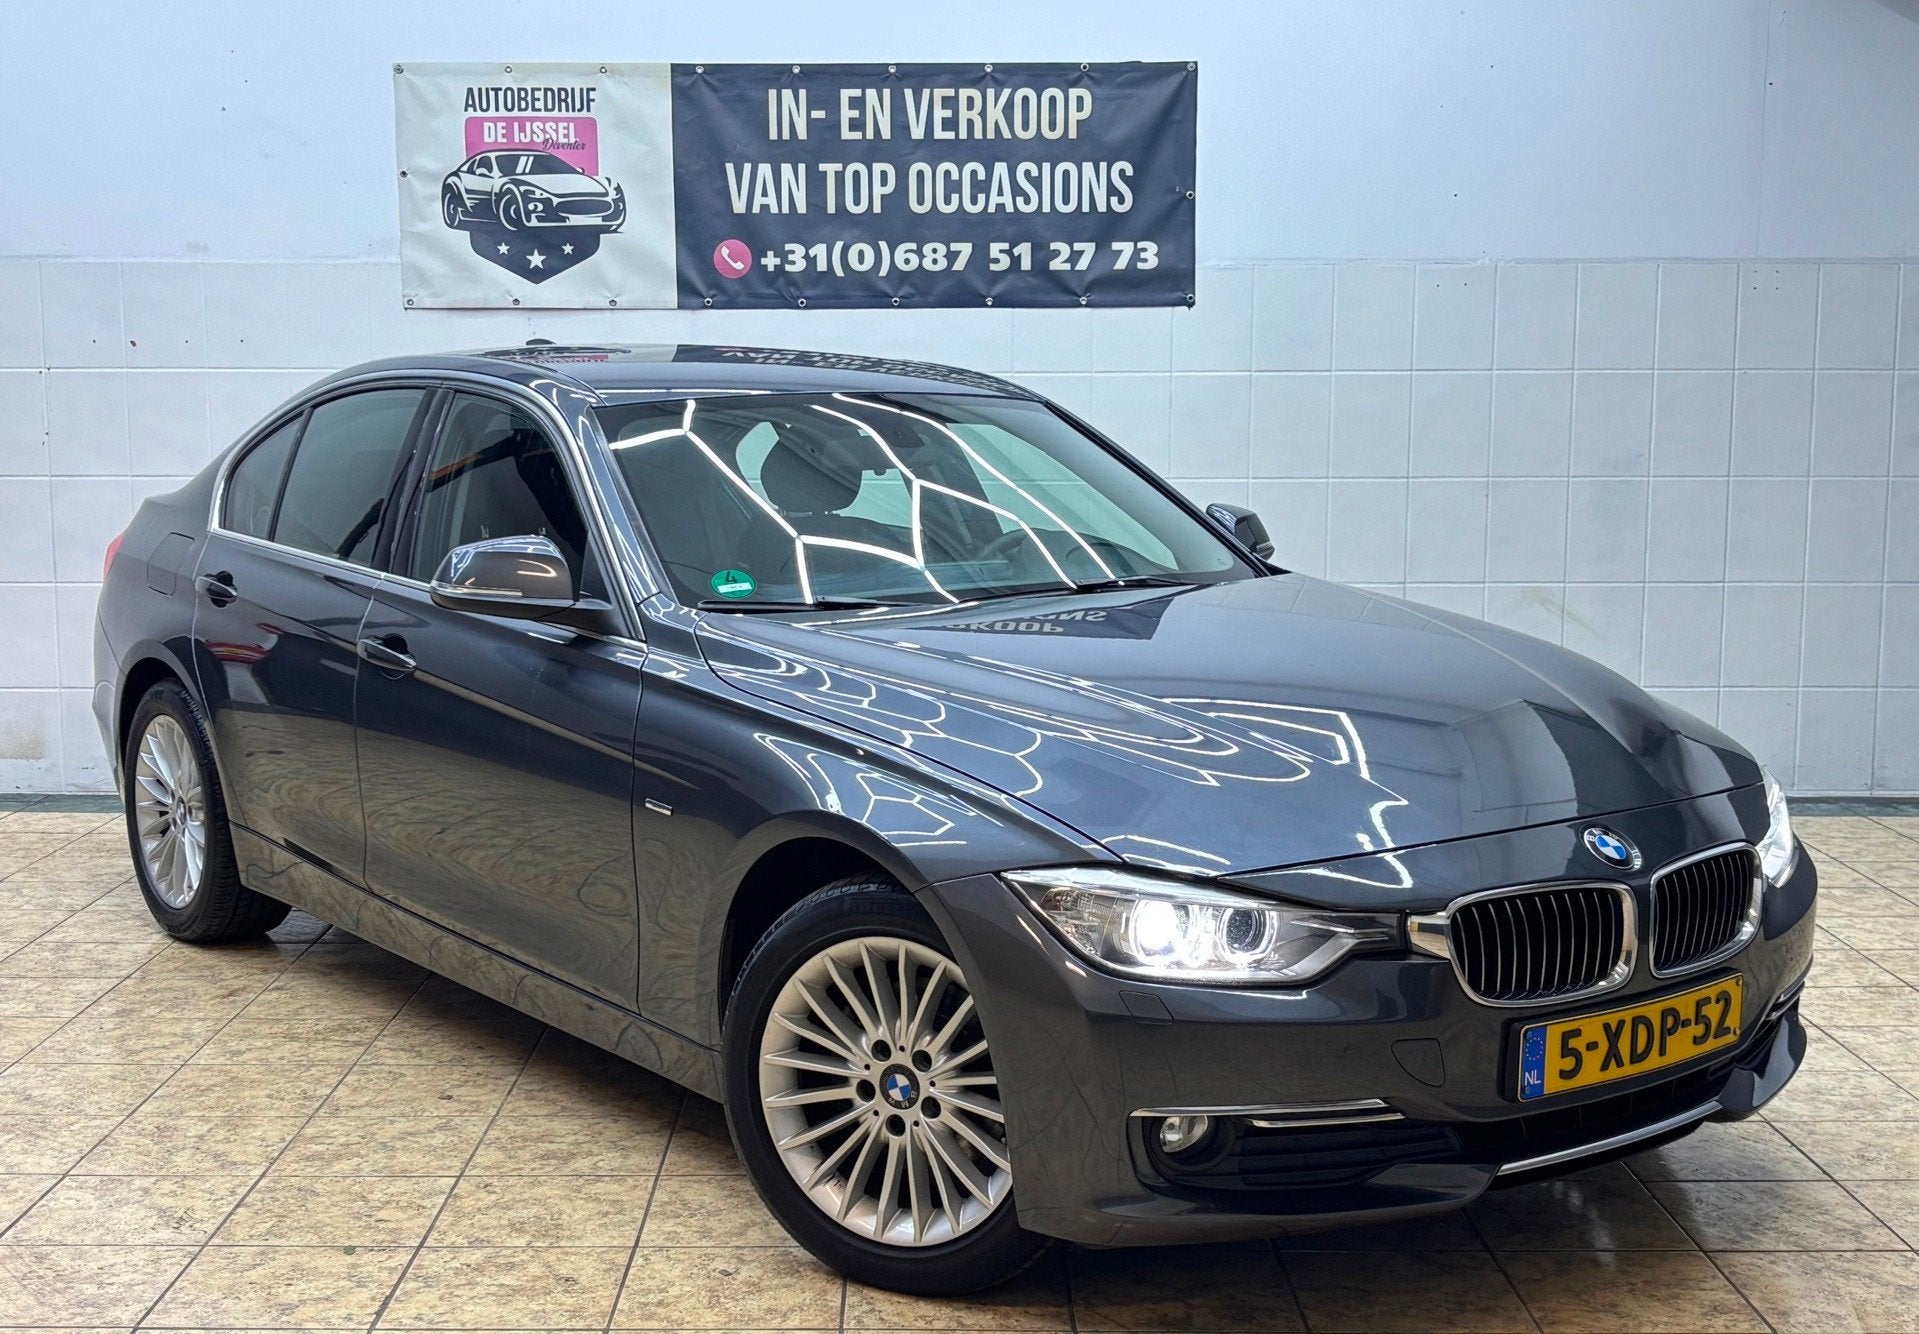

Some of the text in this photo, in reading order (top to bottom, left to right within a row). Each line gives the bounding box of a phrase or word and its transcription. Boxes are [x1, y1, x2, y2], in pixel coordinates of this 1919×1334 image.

[463, 87, 597, 113] AUTOBEDRIJF
[767, 87, 1093, 141] IN- EN VERKOOP
[483, 121, 580, 143] DE IJSSEL
[542, 138, 587, 151] Deventer
[725, 160, 1135, 214] VAN TOP OCCASIONS
[760, 240, 1160, 278] +31(0)687 51 27 73
[1558, 990, 1732, 1081] 5-XDP-52
[1524, 1070, 1542, 1086] NL
